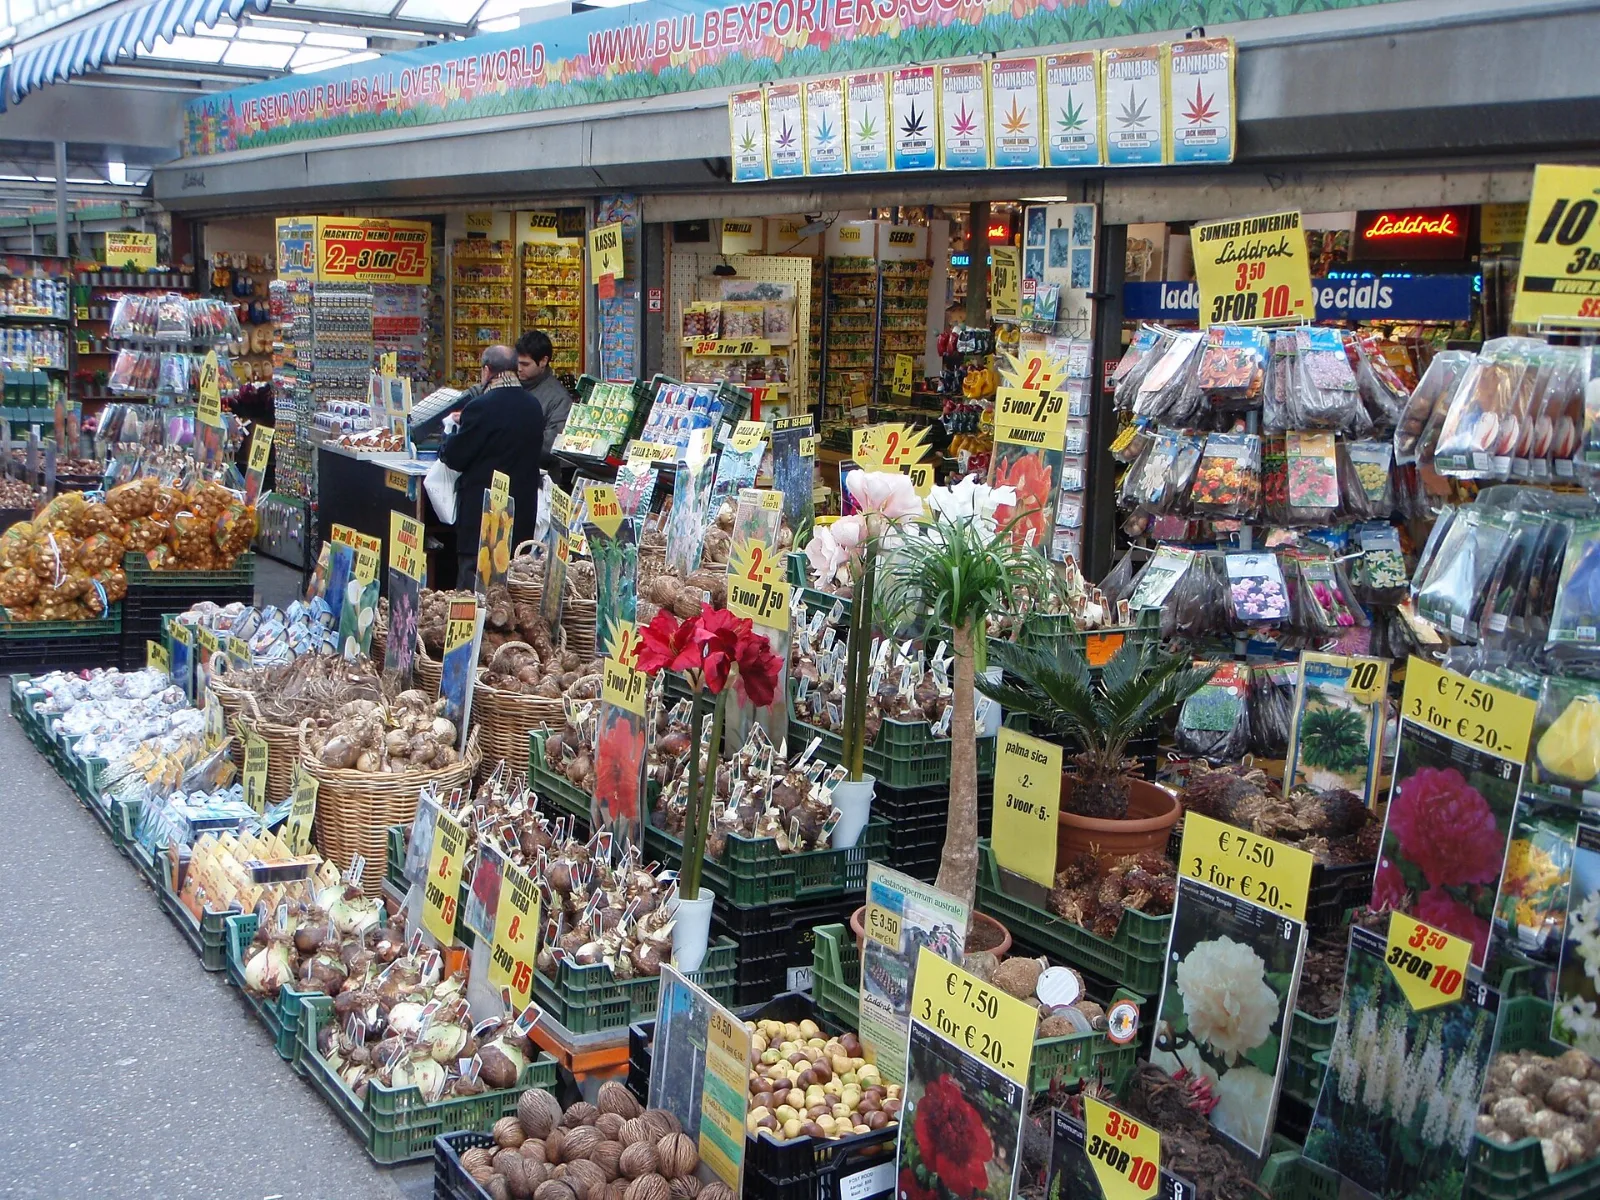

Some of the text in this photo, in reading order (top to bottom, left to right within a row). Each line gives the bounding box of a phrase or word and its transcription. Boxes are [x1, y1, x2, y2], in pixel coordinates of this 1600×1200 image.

[1047, 65, 1094, 85] CANNABIS
[1107, 60, 1158, 79] CANNABIS
[1172, 52, 1228, 74] CANNABIS
[241, 43, 545, 125] WE SEND YOUR BULBS ALL OVER THE WORLD
[848, 84, 884, 101] CANNABIS
[893, 77, 933, 94] CANNABIS
[943, 75, 983, 93] CANNABIS
[992, 70, 1036, 88] CANNABIS
[323, 229, 363, 240] MAGNETIC
[366, 231, 390, 241] MEMO
[393, 232, 426, 242] HOLDERS
[839, 227, 861, 240] Semi
[889, 231, 915, 244] SEEDS
[1199, 212, 1299, 243] SUMMER FLOWERING
[1365, 214, 1454, 238] Laddrak
[594, 231, 618, 253] KASSA
[1214, 236, 1294, 265] Laddrak
[358, 249, 371, 269] 3
[371, 249, 398, 269] for
[1235, 261, 1266, 292] 3.50
[1262, 284, 1304, 319] 10.-
[1312, 279, 1393, 309] ecials
[696, 342, 759, 354] 3.50 3 for 10.-
[1022, 357, 1051, 391] 2.-
[1002, 390, 1063, 423] 5 voor 7.50
[882, 431, 910, 465] 2.-
[1008, 428, 1046, 443] AMARYLLIS
[747, 547, 771, 583] 2.-
[731, 583, 784, 618] 5 voor 7.50
[606, 665, 642, 703] 5 voor 7.50
[1208, 677, 1234, 685] ERONICA
[1437, 675, 1494, 713] € 7.50
[1412, 698, 1423, 717] 3
[1427, 705, 1452, 730] for
[1456, 717, 1470, 738] €
[1472, 724, 1513, 752] 20.-
[1004, 740, 1048, 766] palma sica
[1006, 794, 1013, 808] 3
[1013, 796, 1034, 815] voor
[440, 836, 457, 858] MEGA
[1218, 831, 1275, 869] € 7.50
[438, 855, 452, 880] 8.-
[1191, 857, 1293, 911] 3 for € 20.-
[442, 895, 457, 926] 15
[510, 886, 531, 916] MEGA
[508, 915, 525, 944] 8.-
[1408, 924, 1449, 952] 3.50
[511, 960, 533, 995] 15
[1387, 946, 1463, 996] 3FOR 10
[863, 993, 893, 1015] Laddrak
[946, 972, 999, 1020] € 7.50
[921, 998, 1016, 1069] 3 for € 20.-
[1057, 1118, 1084, 1140] Eremurus
[1105, 1111, 1140, 1142] 3.50
[1088, 1134, 1158, 1192] 3FOR 10
